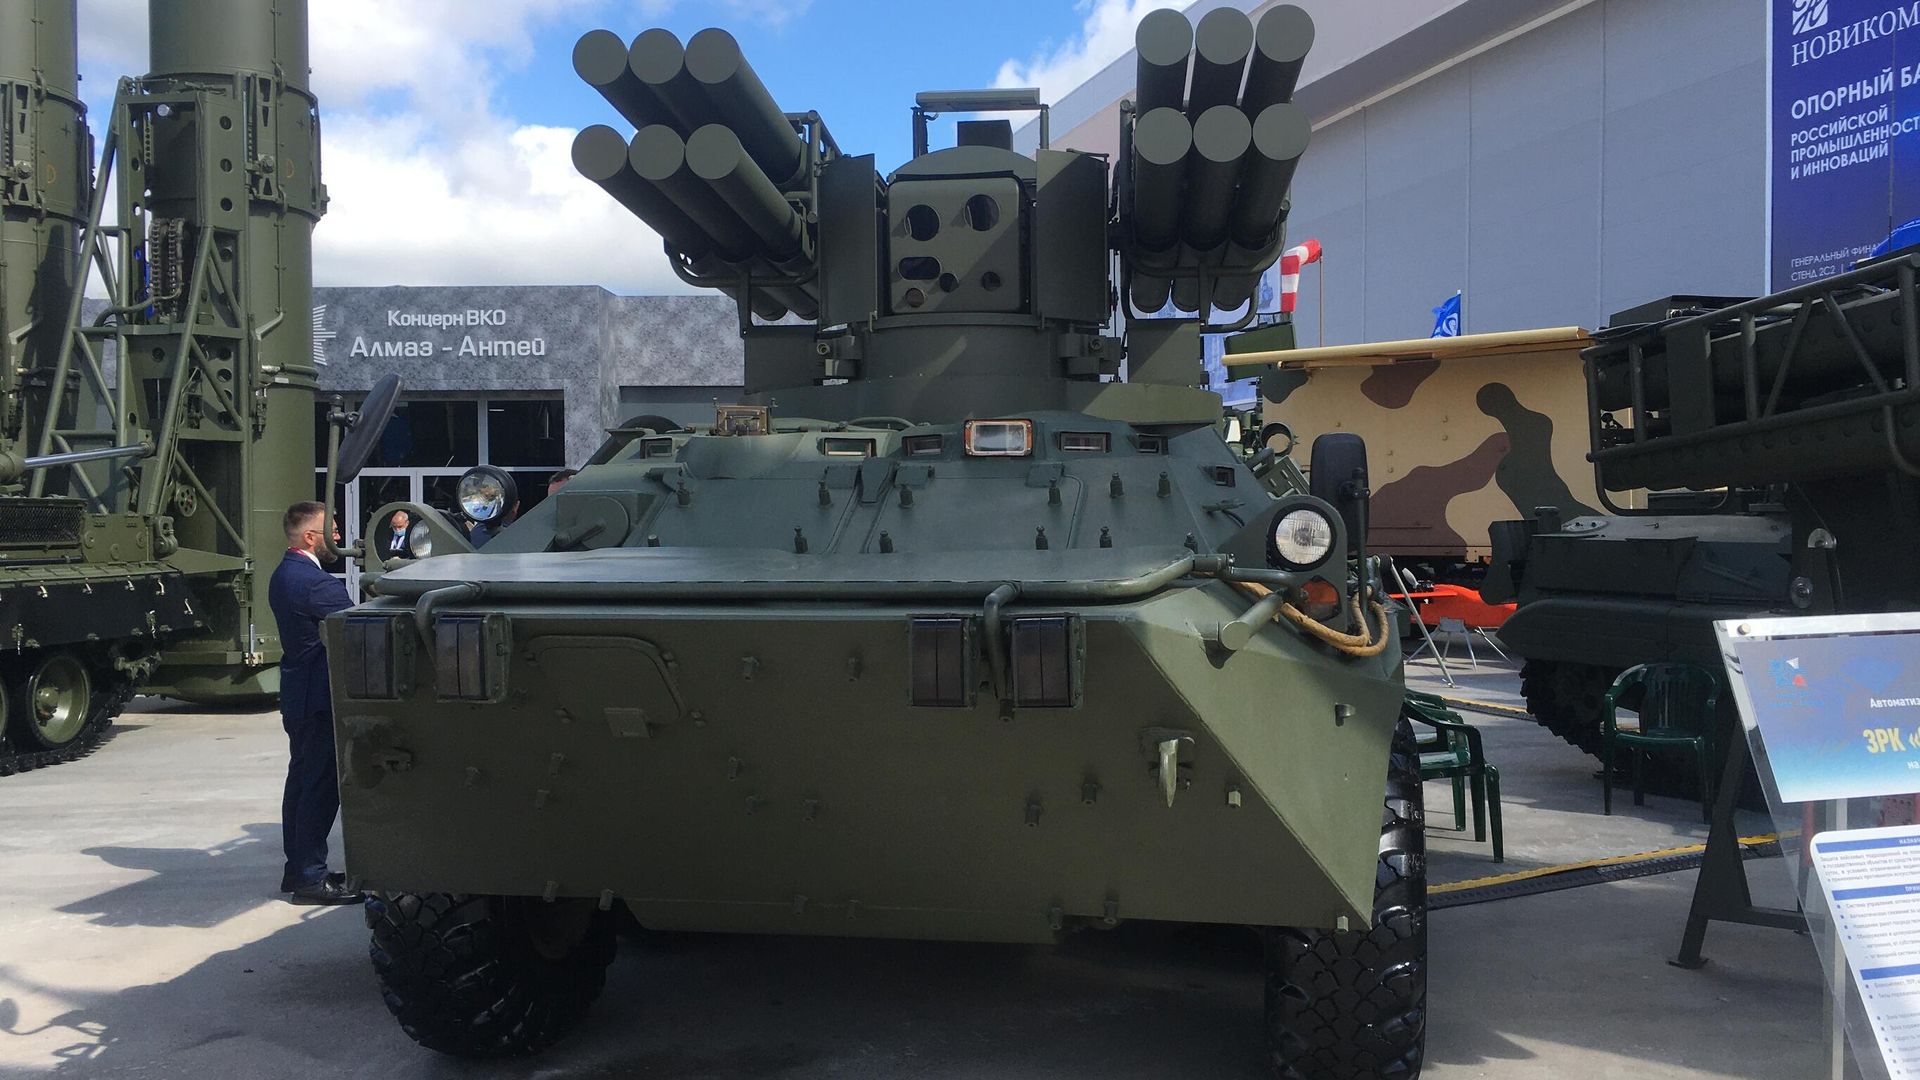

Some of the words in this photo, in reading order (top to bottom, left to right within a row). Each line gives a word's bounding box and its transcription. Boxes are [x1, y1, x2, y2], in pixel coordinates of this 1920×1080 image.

[1791, 1, 1920, 67] НОВИКОМ
[1791, 67, 1893, 119] ОПОРНЫЙ
[1791, 104, 1888, 146] РОССИЙСКОЙ
[1791, 116, 1920, 163] ПРОМЫШЛЕННОСТ
[1791, 167, 1799, 180] И
[1803, 139, 1889, 177] ИННОВАЦИЙ
[1791, 247, 1850, 268] ГЕНЕРАЛЬНЫЙ
[1791, 269, 1817, 281] СТЕНД
[387, 310, 463, 329] Концерн
[466, 309, 506, 326] ВКО
[350, 336, 433, 357] Алмаз
[458, 336, 545, 356] Антей
[1862, 728, 1907, 753] ЗРК
